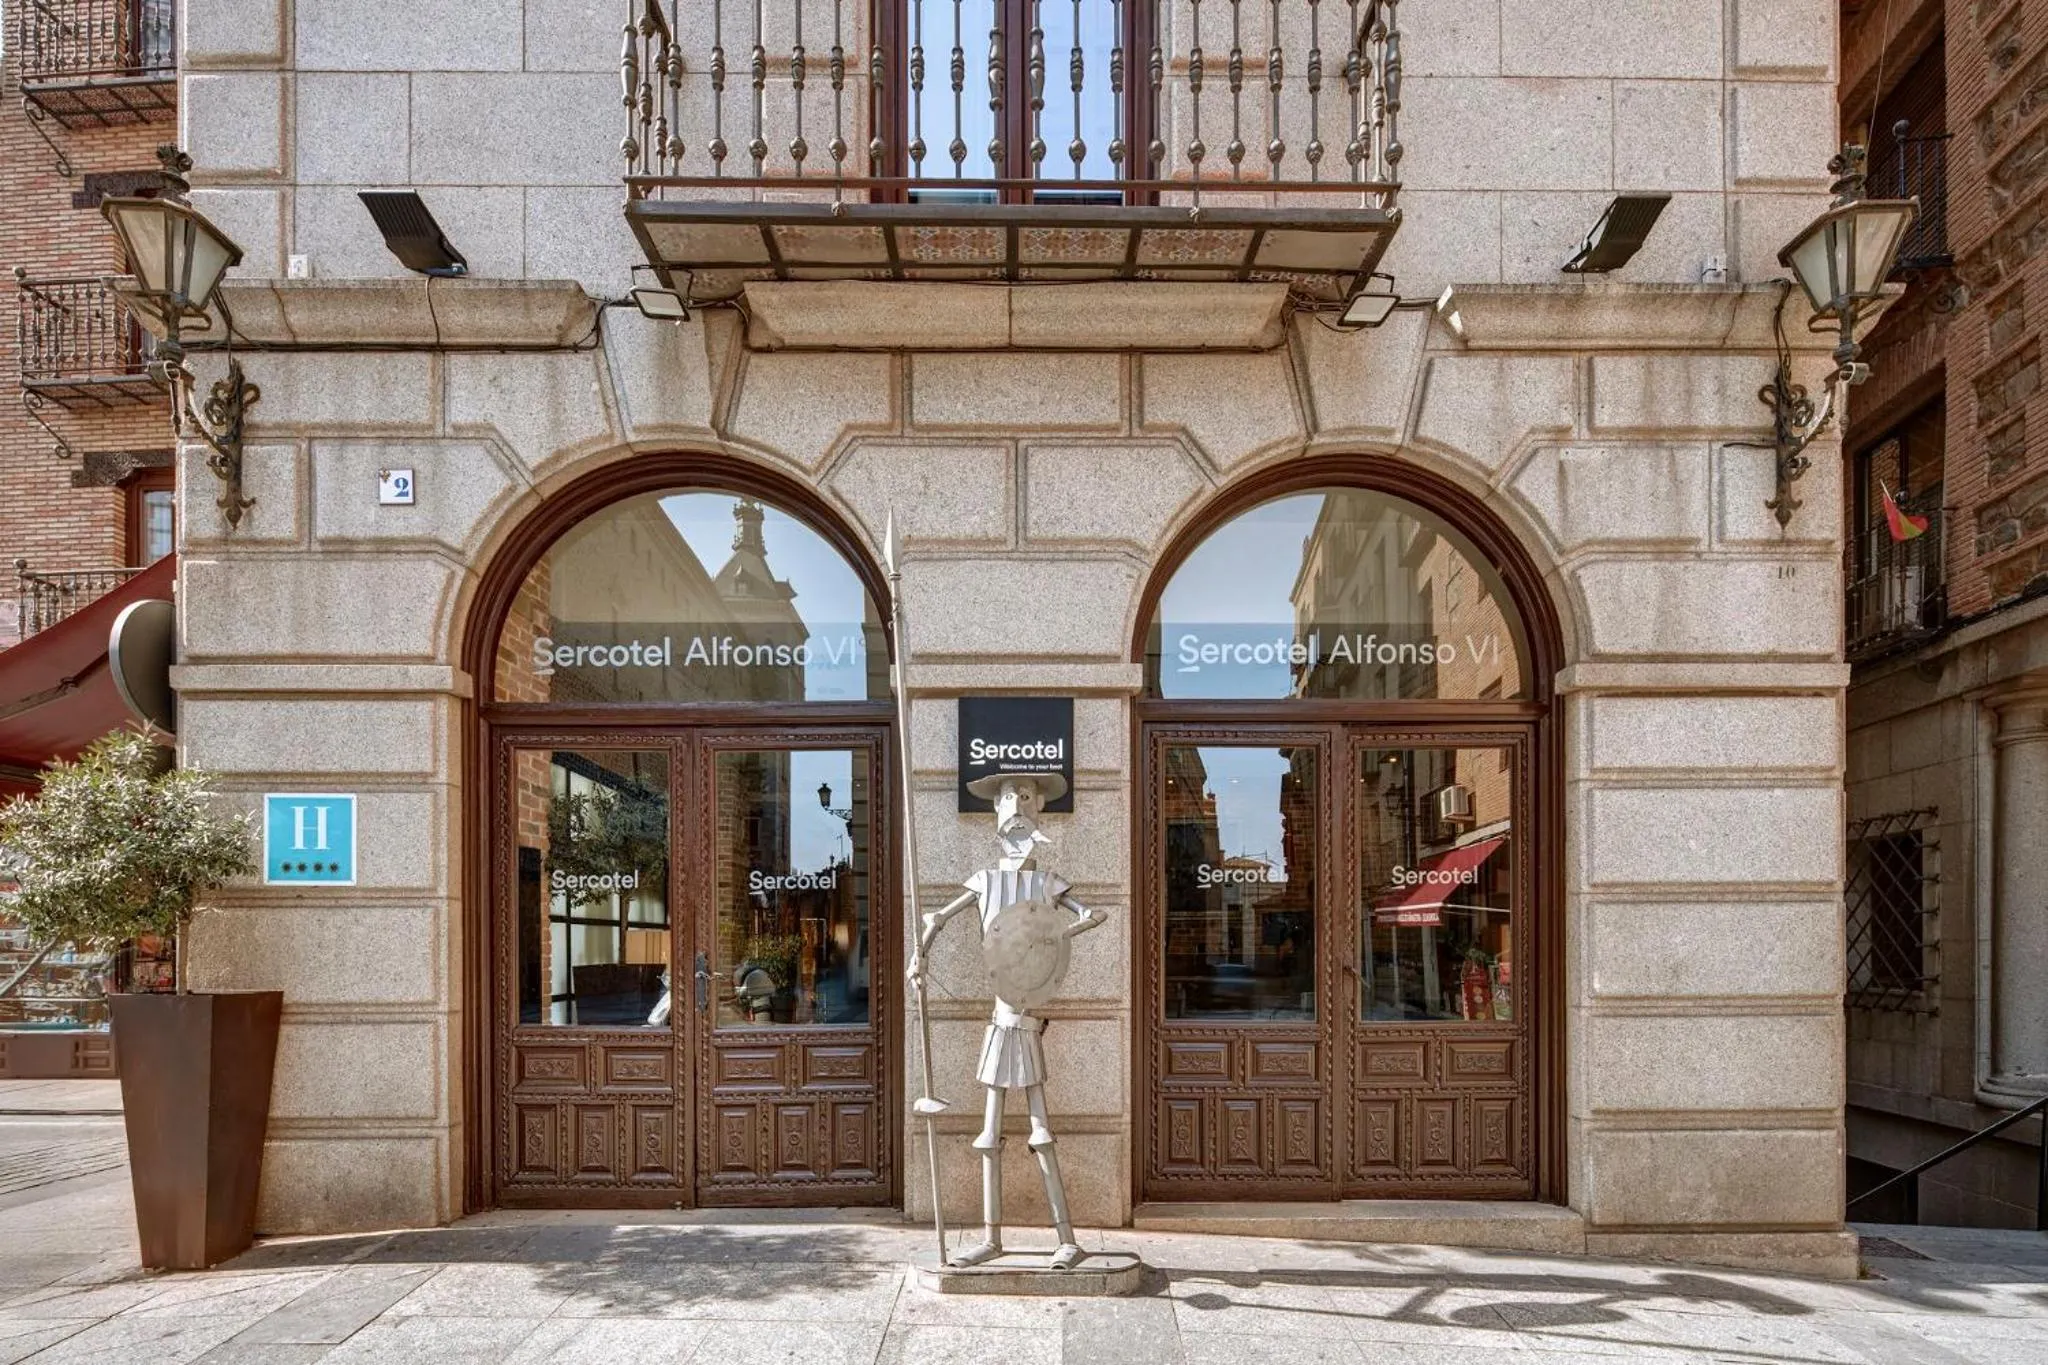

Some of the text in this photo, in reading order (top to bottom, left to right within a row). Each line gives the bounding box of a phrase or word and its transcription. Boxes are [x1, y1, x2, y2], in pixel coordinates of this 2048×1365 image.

[393, 477, 409, 497] 2
[533, 636, 856, 675] Sercotel Alfonso VI
[1178, 633, 1499, 672] Sercotel Alfonso VI
[969, 738, 1063, 765] Sercotel
[289, 806, 332, 850] H
[550, 869, 639, 896] Sercotel
[748, 871, 837, 896] Sercotel
[1391, 865, 1478, 890] Sercotel
